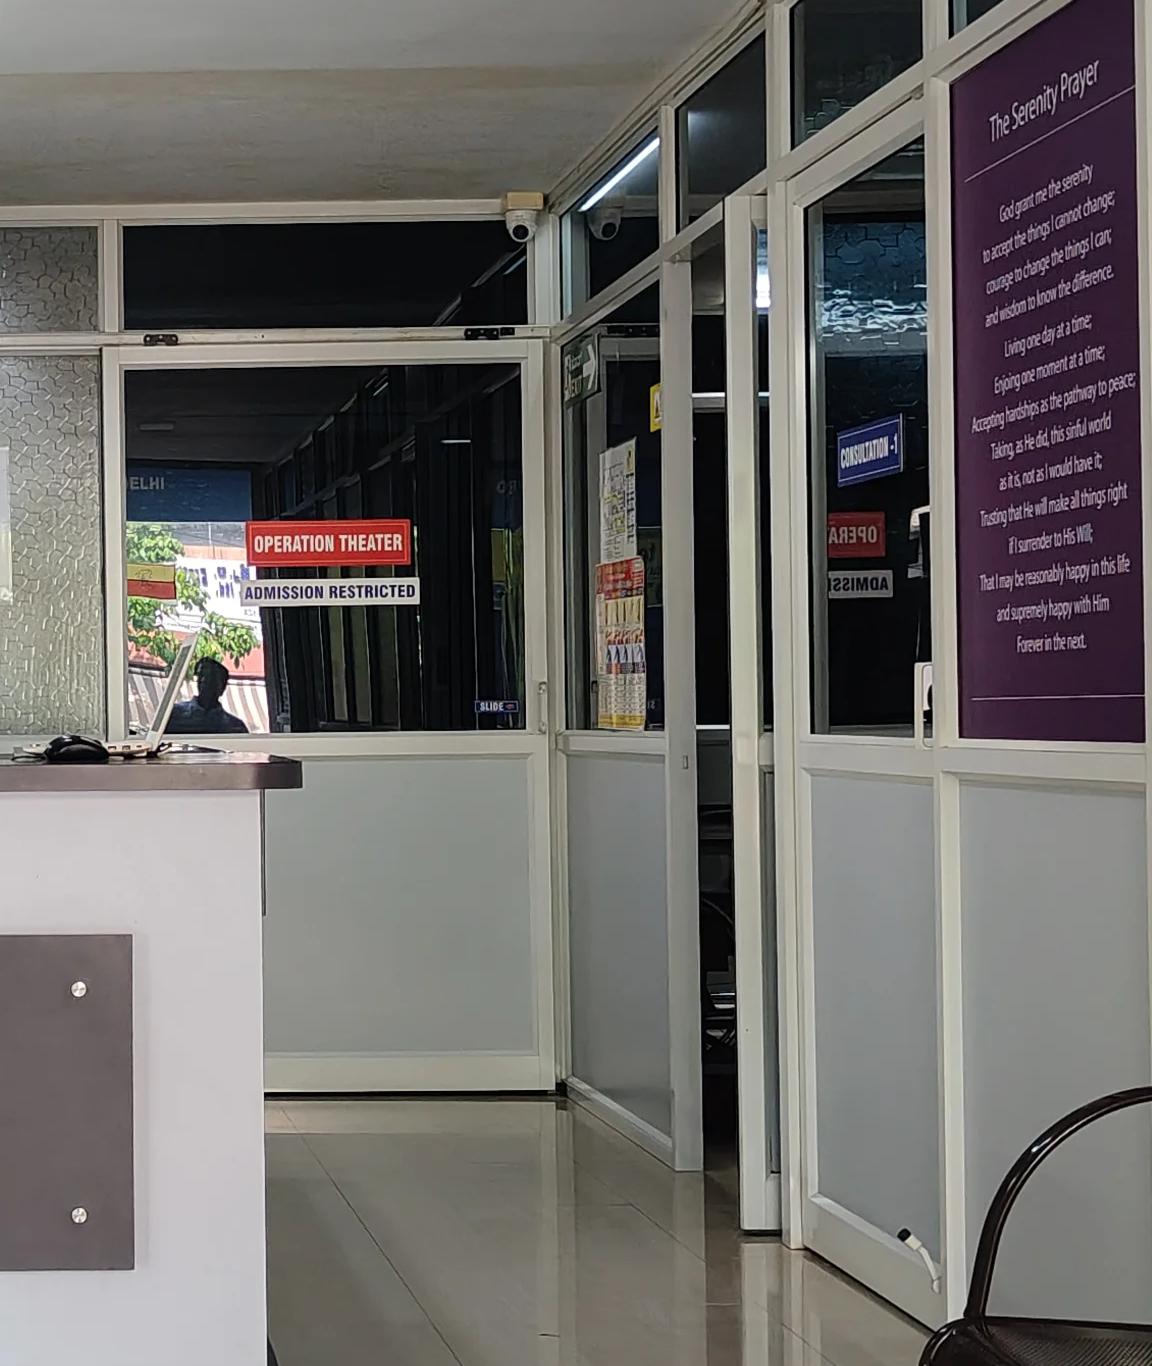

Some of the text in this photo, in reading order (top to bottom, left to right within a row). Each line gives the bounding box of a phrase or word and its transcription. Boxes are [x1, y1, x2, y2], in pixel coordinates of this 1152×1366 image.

[990, 60, 1099, 142] The Serenity Prayer
[1000, 164, 1093, 222] God grant me the serenity
[983, 249, 990, 263] to
[991, 238, 1014, 260] accept
[1015, 230, 1026, 249] the
[1028, 221, 1050, 244] things
[1051, 215, 1053, 231] I
[1055, 205, 1082, 230] cannot
[986, 272, 1014, 294] courage
[1015, 266, 1022, 280] to
[1023, 256, 1050, 279] change
[1051, 247, 1063, 266] the
[1065, 239, 1090, 260] things
[1091, 231, 1093, 249] I
[985, 307, 998, 327] and
[999, 299, 1027, 321] wisdom
[1028, 294, 1035, 310] to
[1037, 289, 1057, 306] know
[1058, 279, 1071, 298] the
[1005, 336, 1026, 357] Living
[1027, 333, 1041, 350] one
[1042, 325, 1055, 345] day
[1057, 323, 1064, 338] at
[1066, 324, 1070, 335] a
[1022, 370, 1035, 385] one
[1036, 357, 1068, 380] moment
[1069, 354, 1076, 369] at
[1078, 353, 1083, 366] a
[972, 410, 1005, 433] Accepting
[1006, 400, 1039, 422] hardships
[1040, 398, 1048, 412] as
[1050, 392, 1062, 408] the
[1064, 384, 1097, 410] pathway
[1099, 381, 1107, 397] to
[1016, 439, 1023, 453] as
[1024, 433, 1035, 451] He
[1051, 425, 1064, 444] this
[1066, 417, 1087, 439] sinful
[1088, 410, 1111, 433] world
[841, 436, 888, 469] CONSULTATION
[999, 475, 1007, 490] as
[1022, 469, 1035, 485] not
[1036, 469, 1044, 482] as
[1045, 463, 1047, 480] I
[1049, 456, 1072, 479] would
[1073, 454, 1093, 473] have
[980, 481, 1128, 527] Trusting that He will make all things right
[254, 534, 402, 552] OPERATION THEATER
[1009, 536, 1013, 554] if
[1015, 536, 1017, 553] I
[1018, 531, 1052, 553] surrender
[1054, 530, 1062, 547] to
[1063, 528, 1075, 545] His
[980, 553, 1130, 591] That I may be reasonably happy in this life
[245, 584, 415, 599] ADMISSION RESTRICTED
[997, 594, 1109, 624] and supremely happy with Him
[1017, 636, 1043, 653] Forever
[1045, 635, 1052, 650] in
[1053, 632, 1065, 650] the
[480, 702, 504, 711] SLIDE
